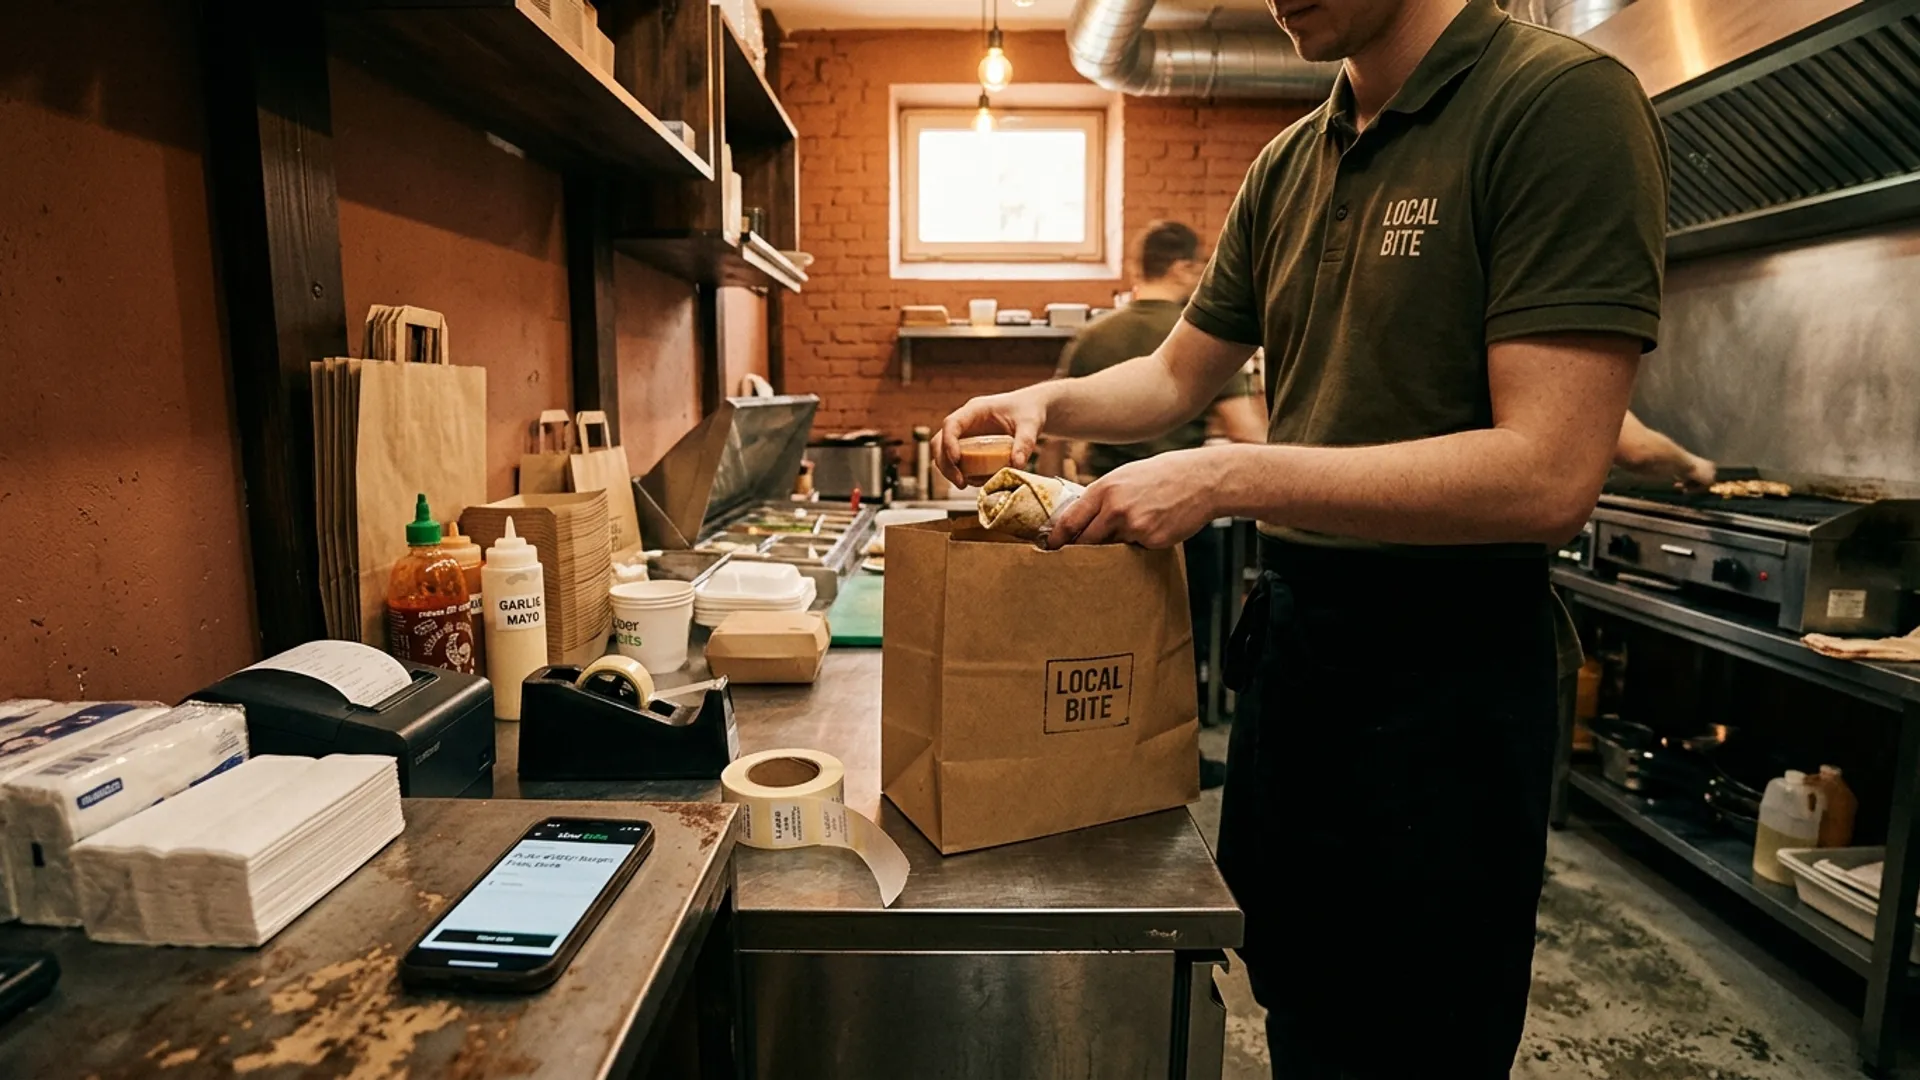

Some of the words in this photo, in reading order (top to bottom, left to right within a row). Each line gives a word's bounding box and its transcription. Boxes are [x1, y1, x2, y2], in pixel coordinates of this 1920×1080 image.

[1382, 198, 1439, 226] LOCAL
[1380, 229, 1425, 256] BITE
[507, 611, 540, 625] MAYO
[1056, 665, 1123, 694] LOCAL
[1065, 695, 1113, 722] BITE
